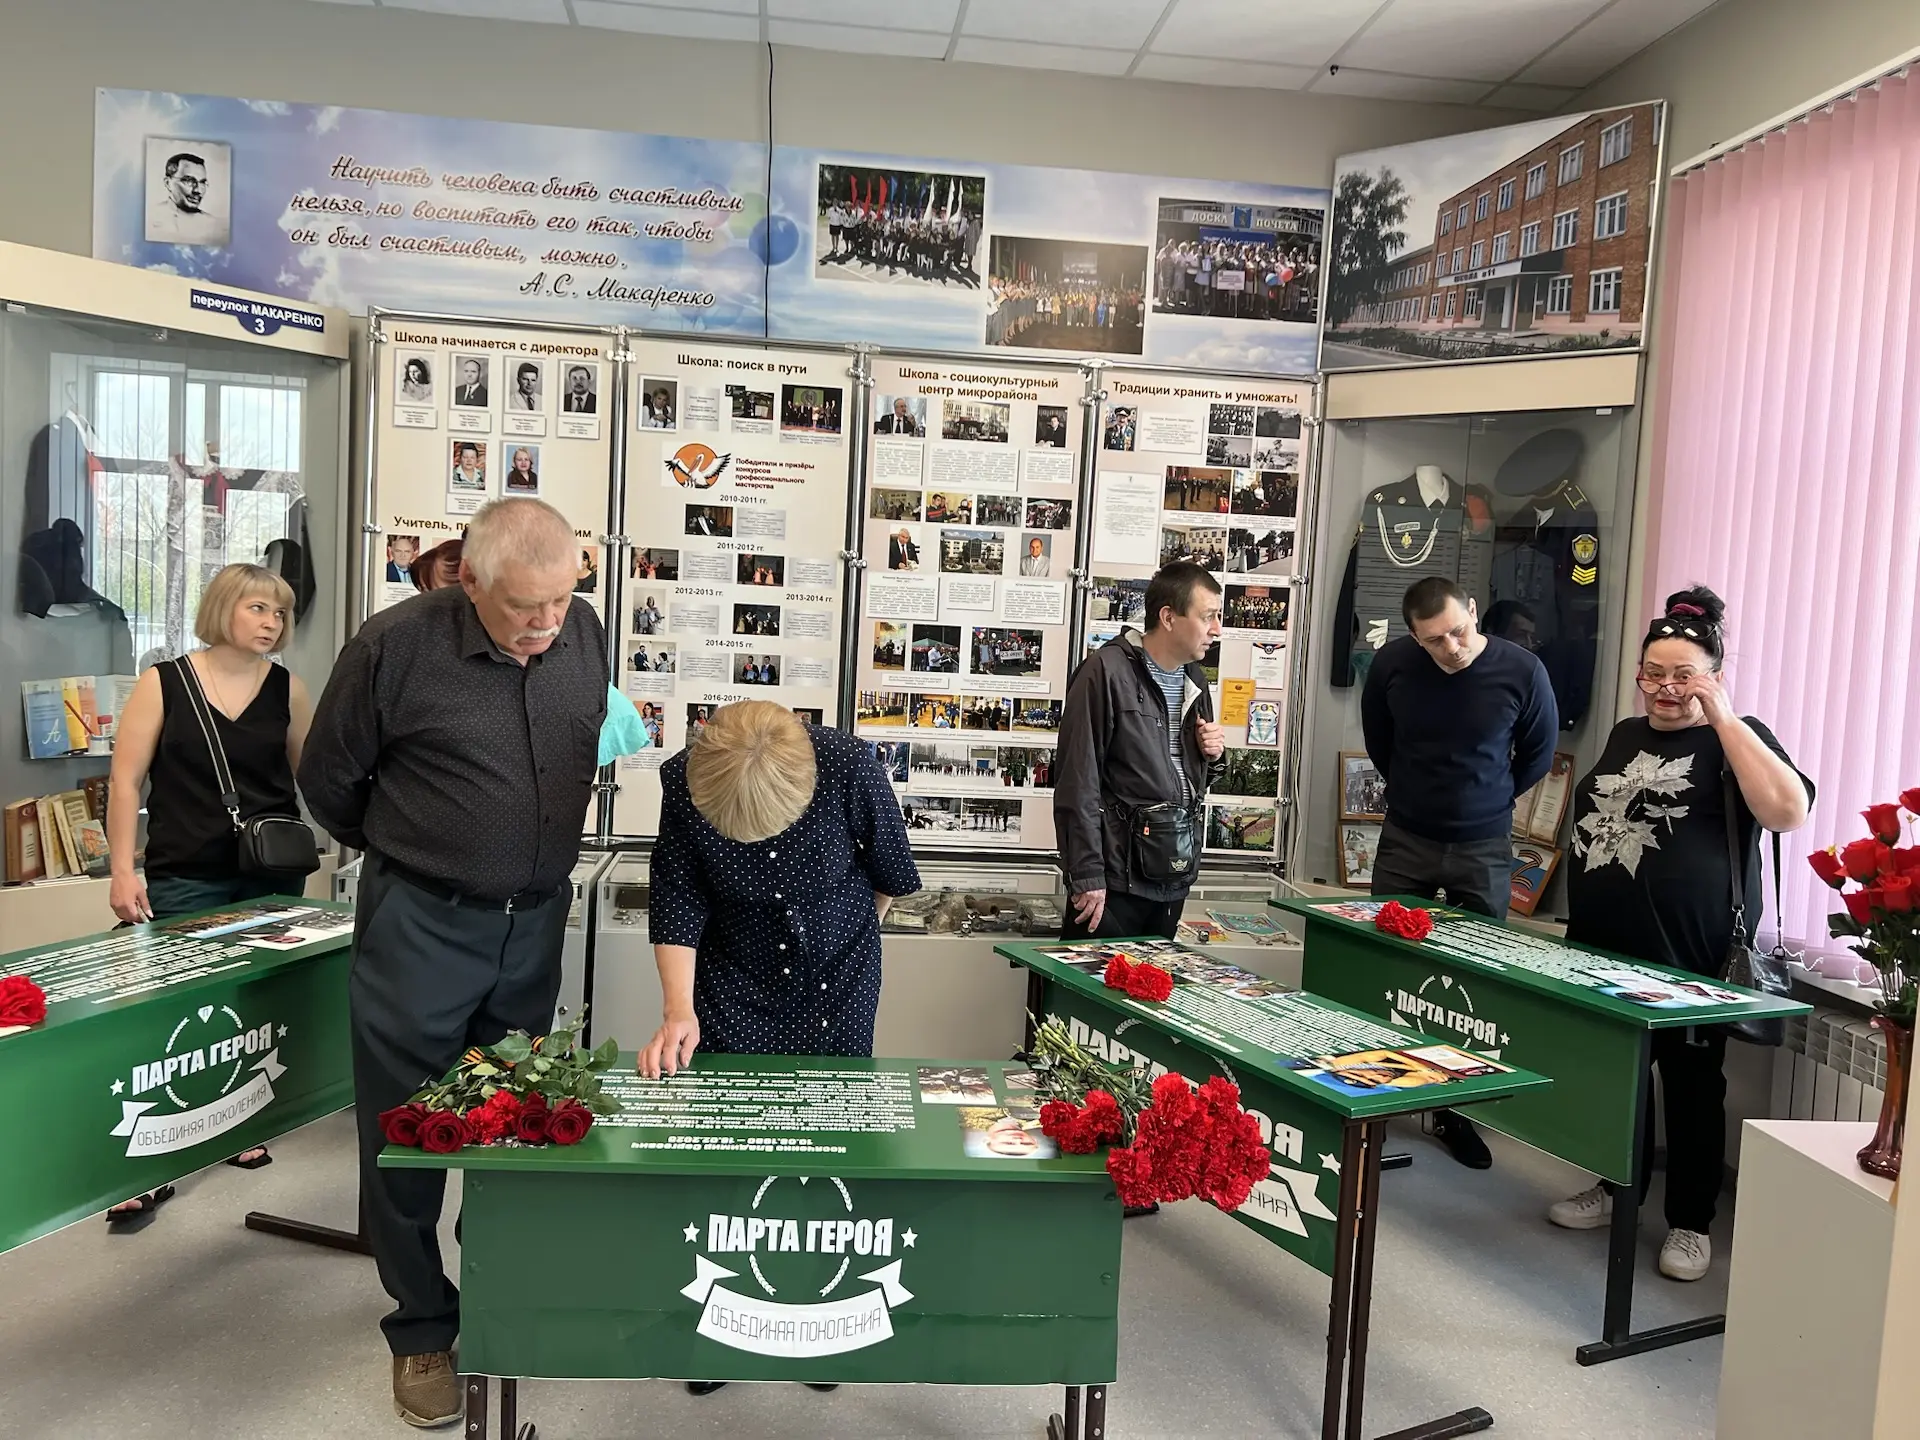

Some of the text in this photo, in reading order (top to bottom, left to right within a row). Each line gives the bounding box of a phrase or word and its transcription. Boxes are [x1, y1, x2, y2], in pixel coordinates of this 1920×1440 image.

[330, 156, 743, 211] Научить человека быть счастливым
[290, 195, 713, 241] нельзя, но воспитать его так, чтобы
[1191, 211, 1298, 231] ДОСКА ПОЧЕТА
[290, 226, 627, 269] он был счастливым, можно.
[587, 277, 715, 309] Макаренко
[192, 294, 323, 328] переулок МАКАРЕНКО
[254, 318, 265, 333] 3
[394, 331, 599, 358] Школа начинается с директора
[677, 354, 807, 376] Школа: поиск в пути
[898, 367, 939, 381] Школа
[949, 372, 1059, 389] социокультурный
[918, 385, 1038, 401] центр микрорайона
[1113, 381, 1298, 405] Традиции хранить и умножать!
[735, 457, 778, 467] Победители
[735, 467, 771, 475] конкурсов
[735, 474, 805, 485] профессионального
[735, 482, 775, 490] мастерства
[719, 494, 757, 504] 2010-2011
[394, 516, 453, 532] Учитель,
[717, 542, 755, 552] 2011-2012
[674, 586, 714, 596] 2012-2013
[785, 593, 823, 603] 2013-2014
[705, 639, 744, 649] 2014-2015
[703, 693, 741, 702] 2016-2017
[1397, 989, 1445, 1026] ПАРТА
[1446, 1010, 1497, 1047] ГЕРОЯ
[132, 1022, 272, 1096] ПАРТА ГЕРОЯ
[137, 1084, 267, 1147] ОБЪЕДИНЯЯ ПОКОЛЕНИЯ
[707, 1213, 893, 1257] ПАРТА ГЕРОЯ
[710, 1304, 882, 1342] ОБЪЕДИНЯЯ ПОКОЛЕНИЯ
